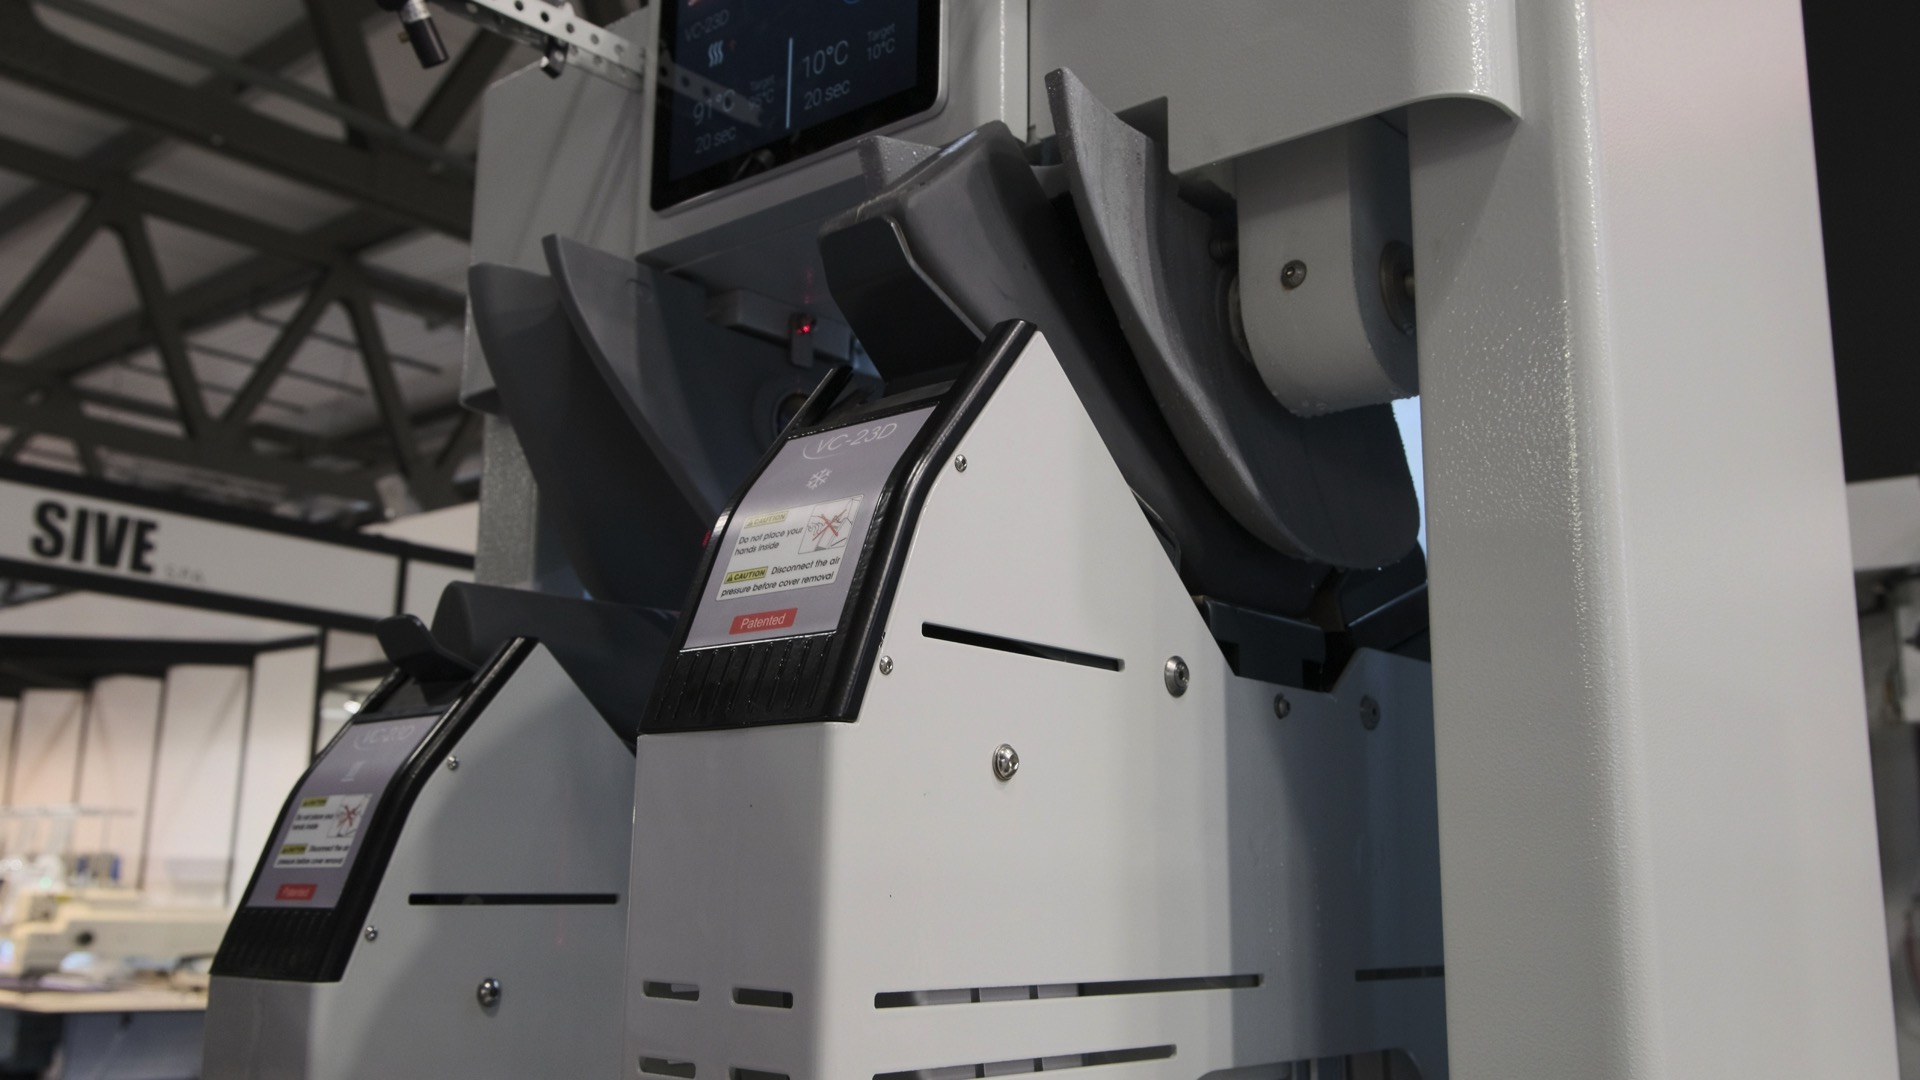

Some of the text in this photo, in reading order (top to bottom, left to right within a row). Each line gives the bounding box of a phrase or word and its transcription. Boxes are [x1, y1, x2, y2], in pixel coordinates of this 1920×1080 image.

[802, 40, 848, 78] 10°C
[803, 79, 851, 111] 20 sec
[816, 422, 898, 455] VC-23D
[30, 499, 159, 575] SIVE
[734, 541, 780, 556] hands inside
[738, 527, 804, 545] Do not place your
[733, 556, 841, 581] CAUTION Disconnect the air
[720, 571, 835, 598] pressure before cover removal
[740, 614, 786, 630] Patented
